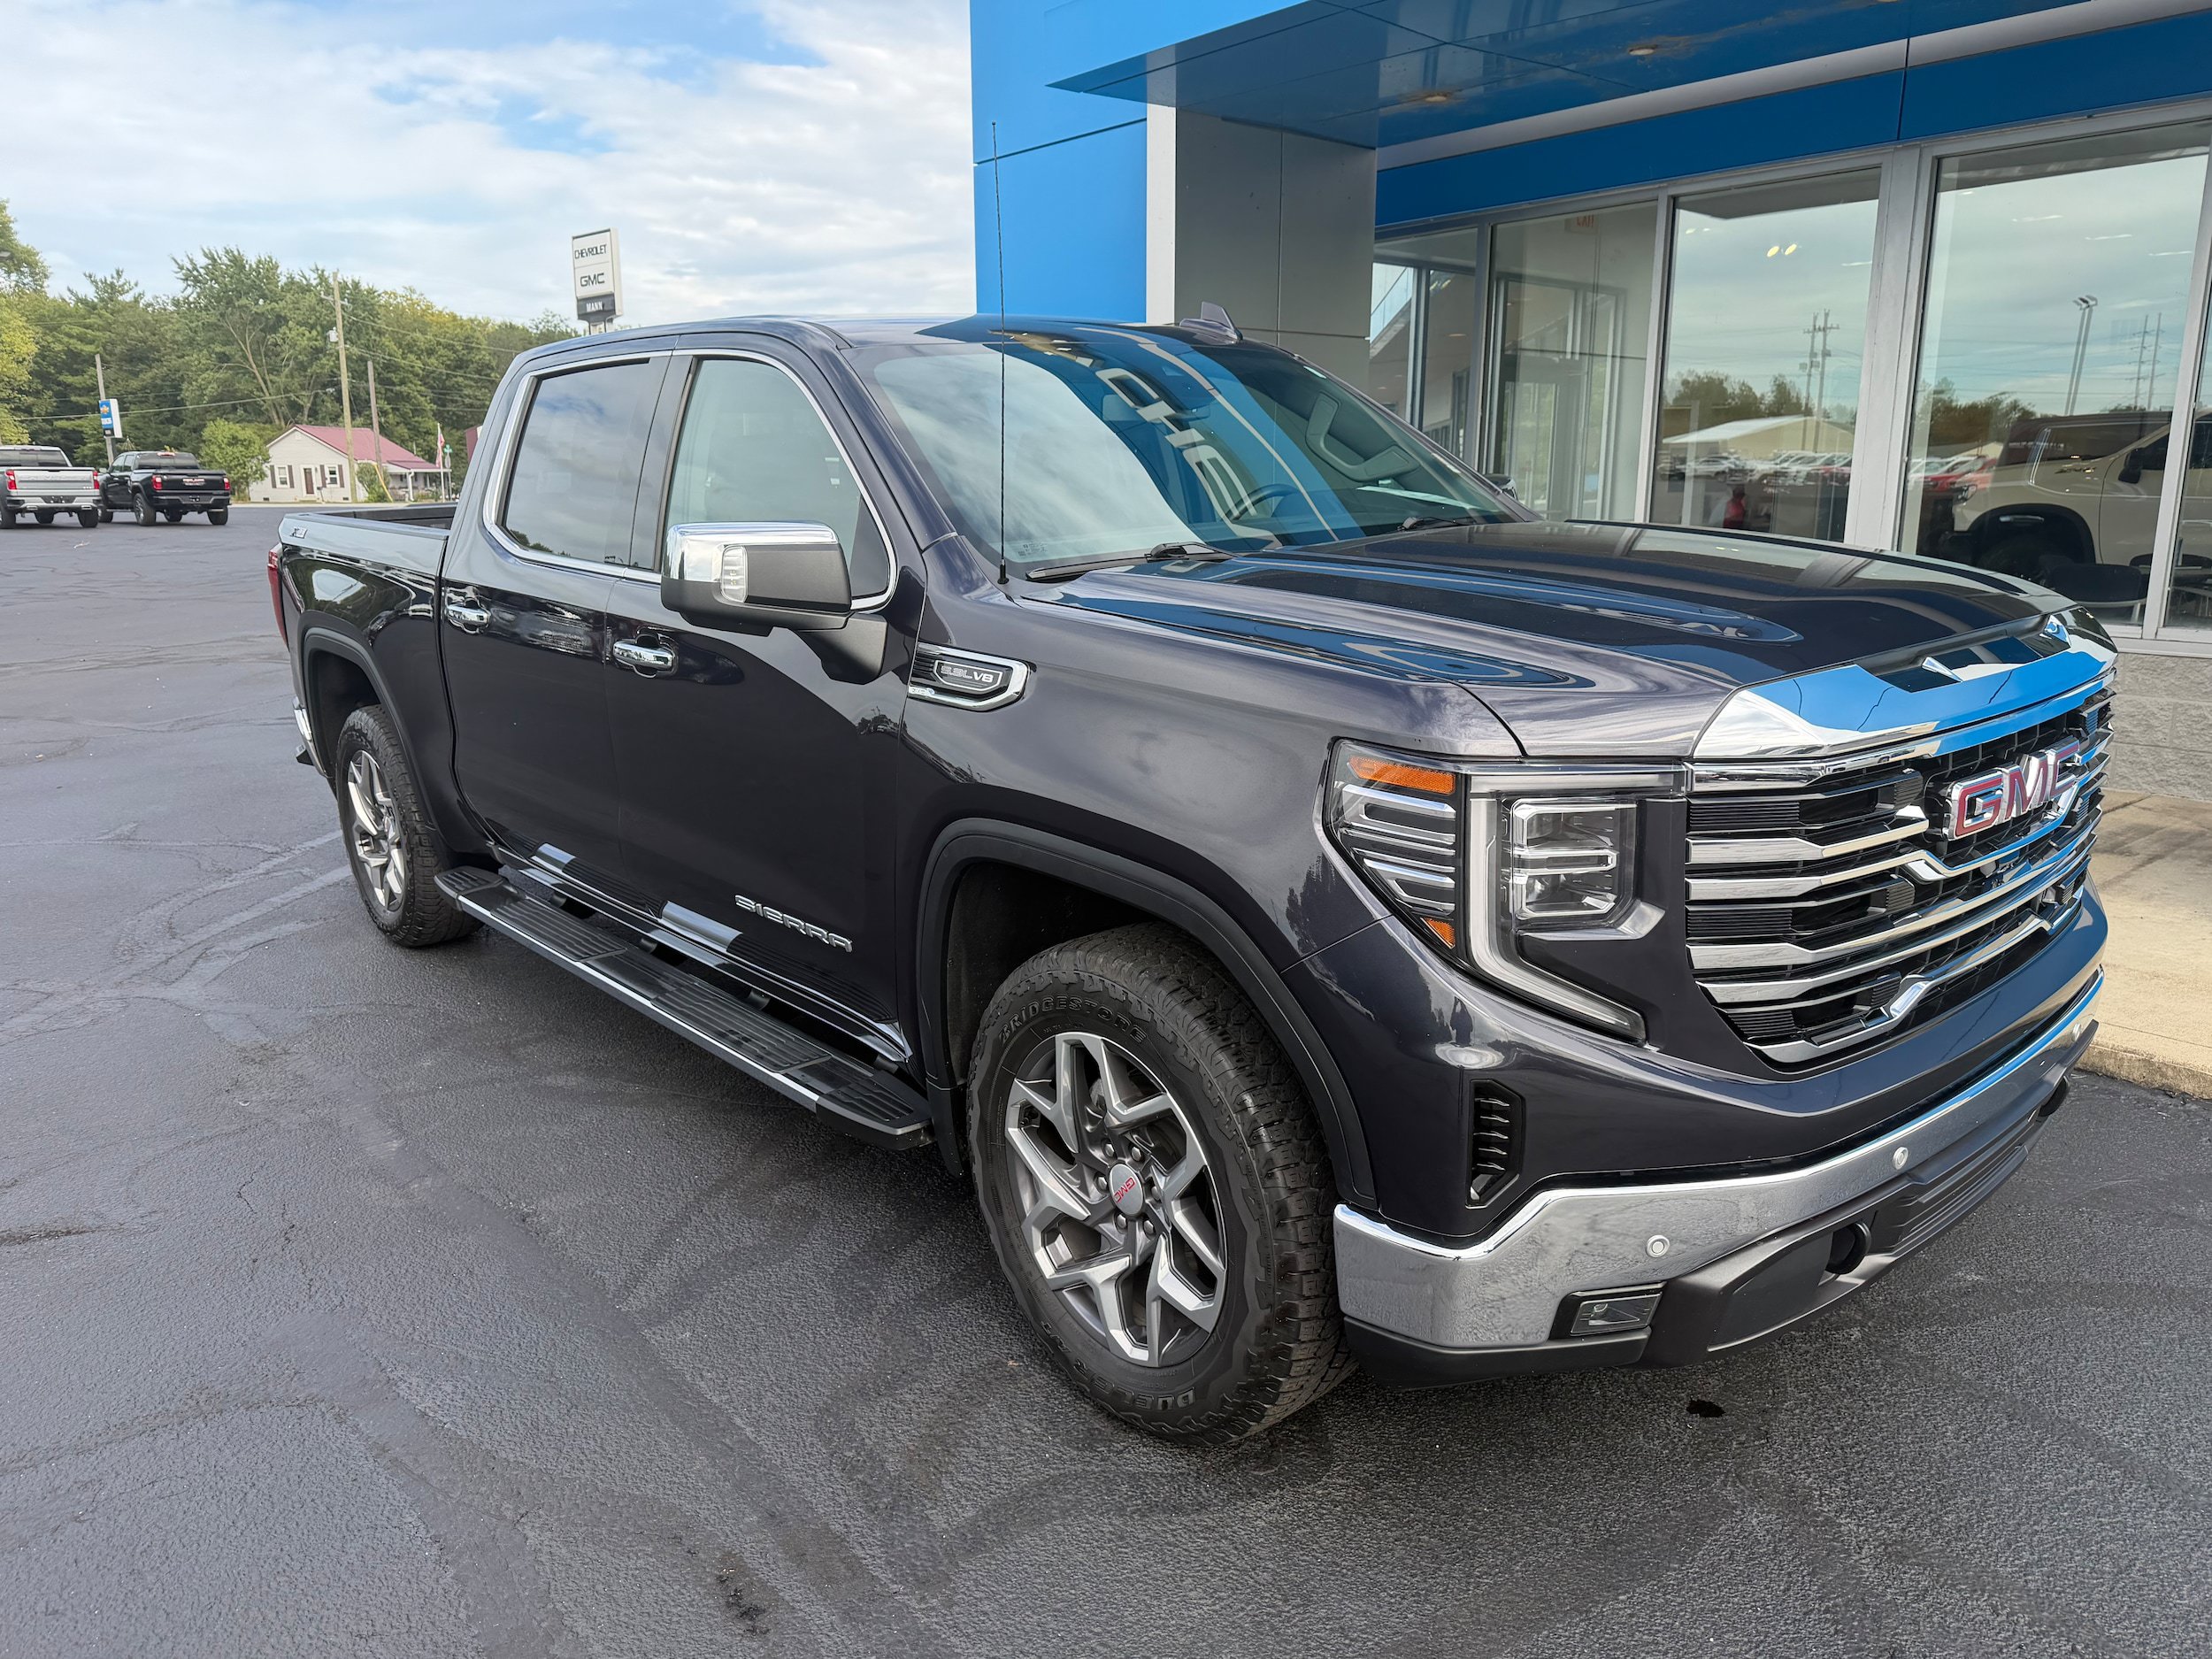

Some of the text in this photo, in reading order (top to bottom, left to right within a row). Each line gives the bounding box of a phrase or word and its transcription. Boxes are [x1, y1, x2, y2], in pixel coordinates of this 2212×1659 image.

[574, 244, 607, 259] CHEVROLET
[580, 273, 605, 287] GMC
[973, 671, 994, 683] V8
[1948, 736, 2080, 841] GMC
[734, 895, 852, 953] SIERRA
[998, 995, 1148, 1044] BRIDGESTONE
[1113, 1177, 1136, 1203] GMC
